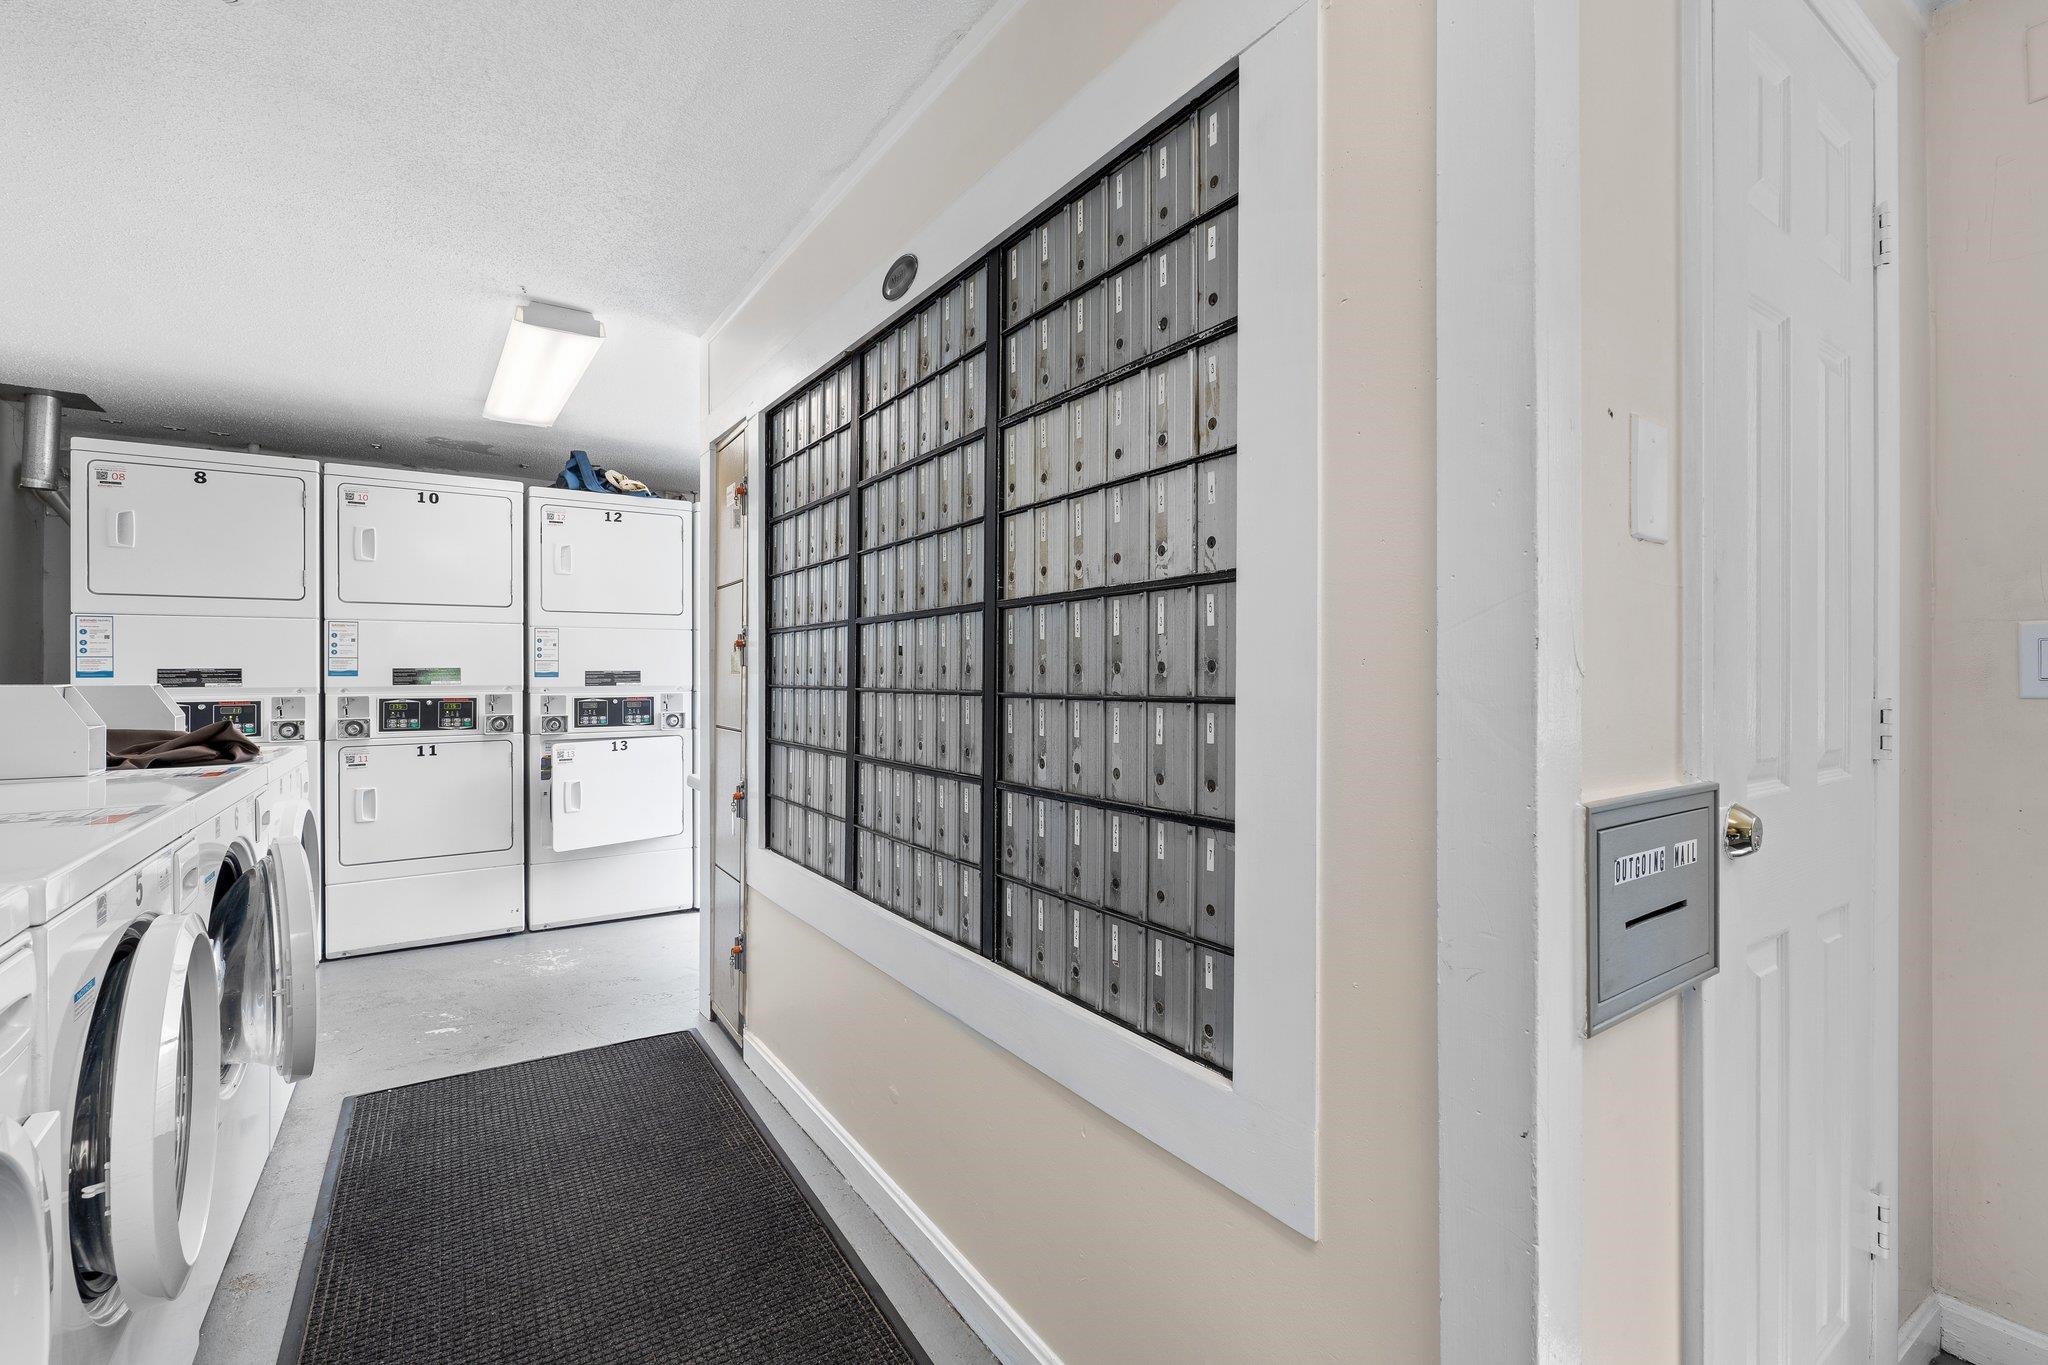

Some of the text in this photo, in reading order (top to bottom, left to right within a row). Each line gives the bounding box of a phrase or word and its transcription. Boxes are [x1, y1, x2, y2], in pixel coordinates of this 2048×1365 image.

[112, 472, 126, 480] 08
[193, 471, 208, 484] 8
[417, 492, 440, 504] 10
[604, 512, 622, 522] 12
[416, 745, 438, 757] 11
[611, 740, 628, 751] 13
[1615, 842, 1696, 883] OUTGOING MAIL
[135, 872, 144, 906] 5
